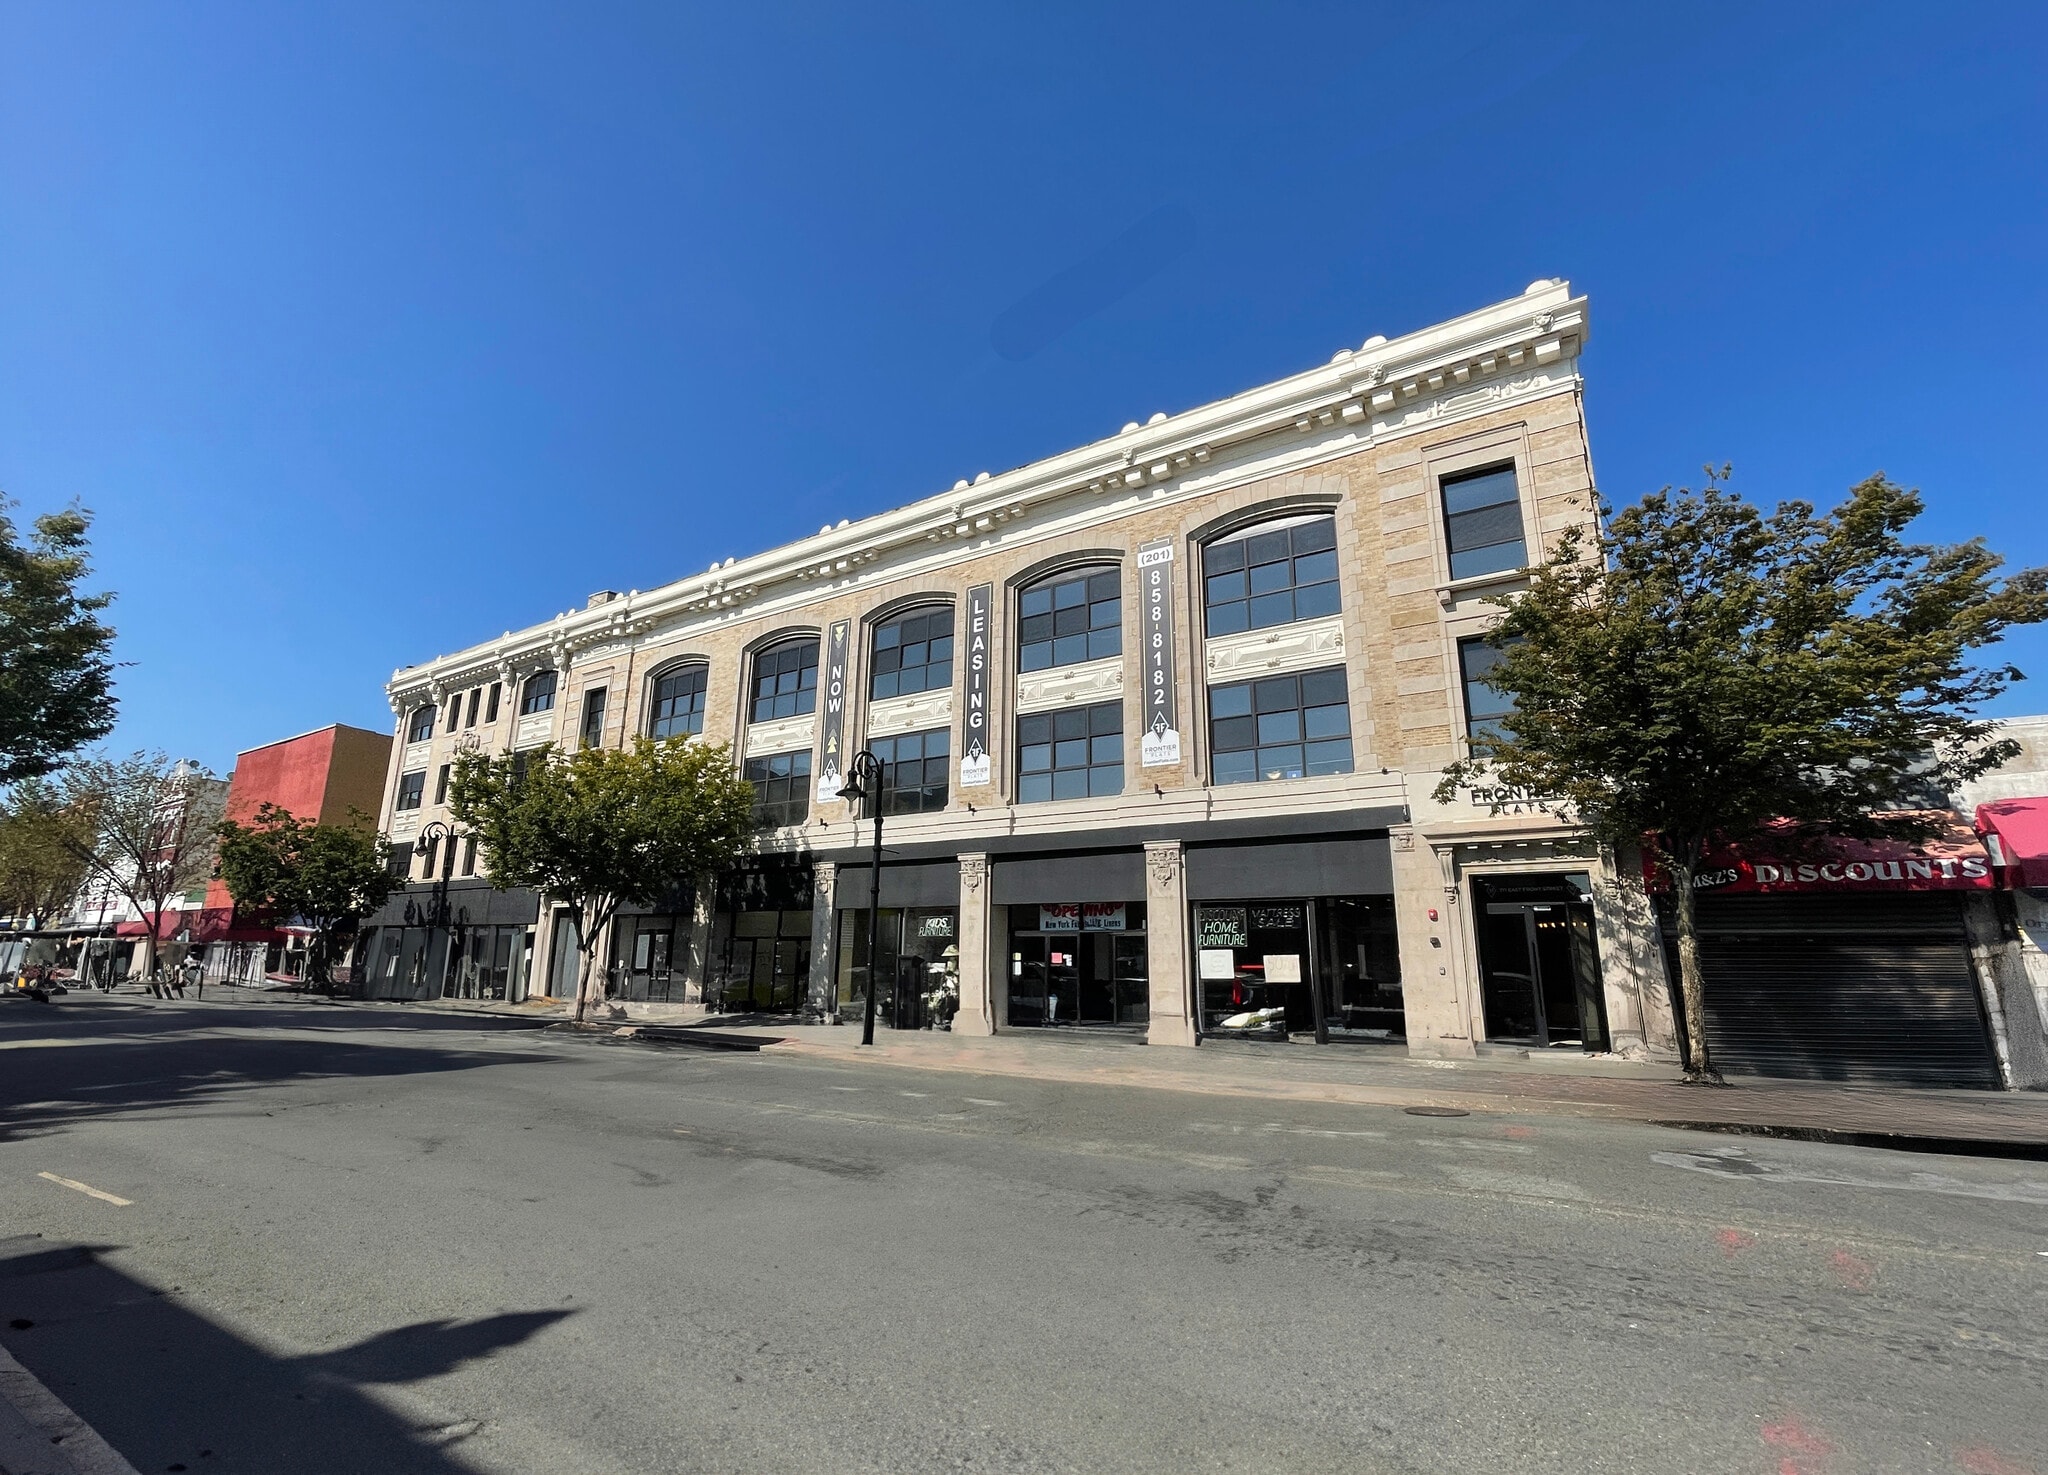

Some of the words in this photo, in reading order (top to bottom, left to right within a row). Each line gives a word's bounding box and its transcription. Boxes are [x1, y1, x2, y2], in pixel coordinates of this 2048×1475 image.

[1141, 549, 1170, 565] (201)
[1150, 570, 1165, 705] 858-8182
[969, 599, 985, 728] LEASING
[828, 664, 842, 713] NOW
[1145, 744, 1177, 753] FRONTIER
[1754, 857, 1988, 883] DISCOUNTS
[1251, 907, 1300, 918] MATTRESS
[925, 917, 949, 928] KIDS
[1045, 921, 1057, 929] New
[1058, 920, 1070, 928] York
[1205, 921, 1239, 933] HOME
[1257, 917, 1294, 928] SALE
[1199, 933, 1246, 946] FURNITURE
